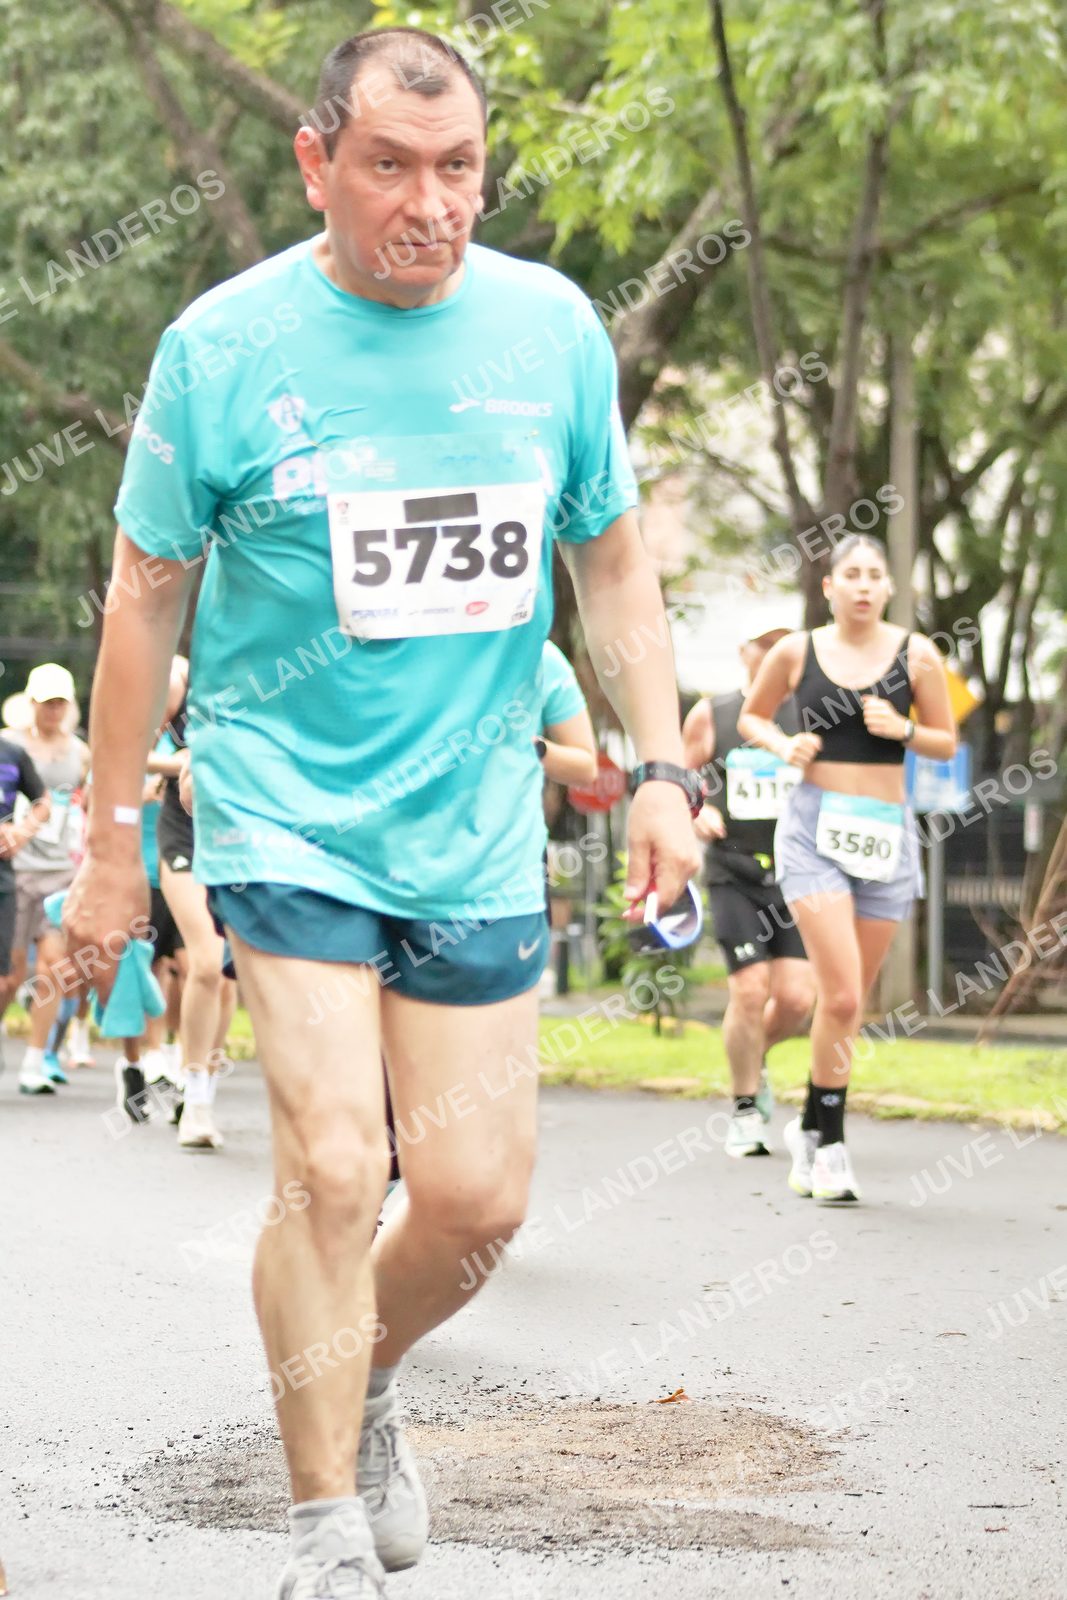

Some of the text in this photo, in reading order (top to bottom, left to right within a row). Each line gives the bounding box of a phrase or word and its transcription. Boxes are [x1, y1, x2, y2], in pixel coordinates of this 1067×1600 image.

[485, 400, 552, 416] BROOKS
[352, 521, 529, 587] 5738
[827, 828, 892, 859] 3580
